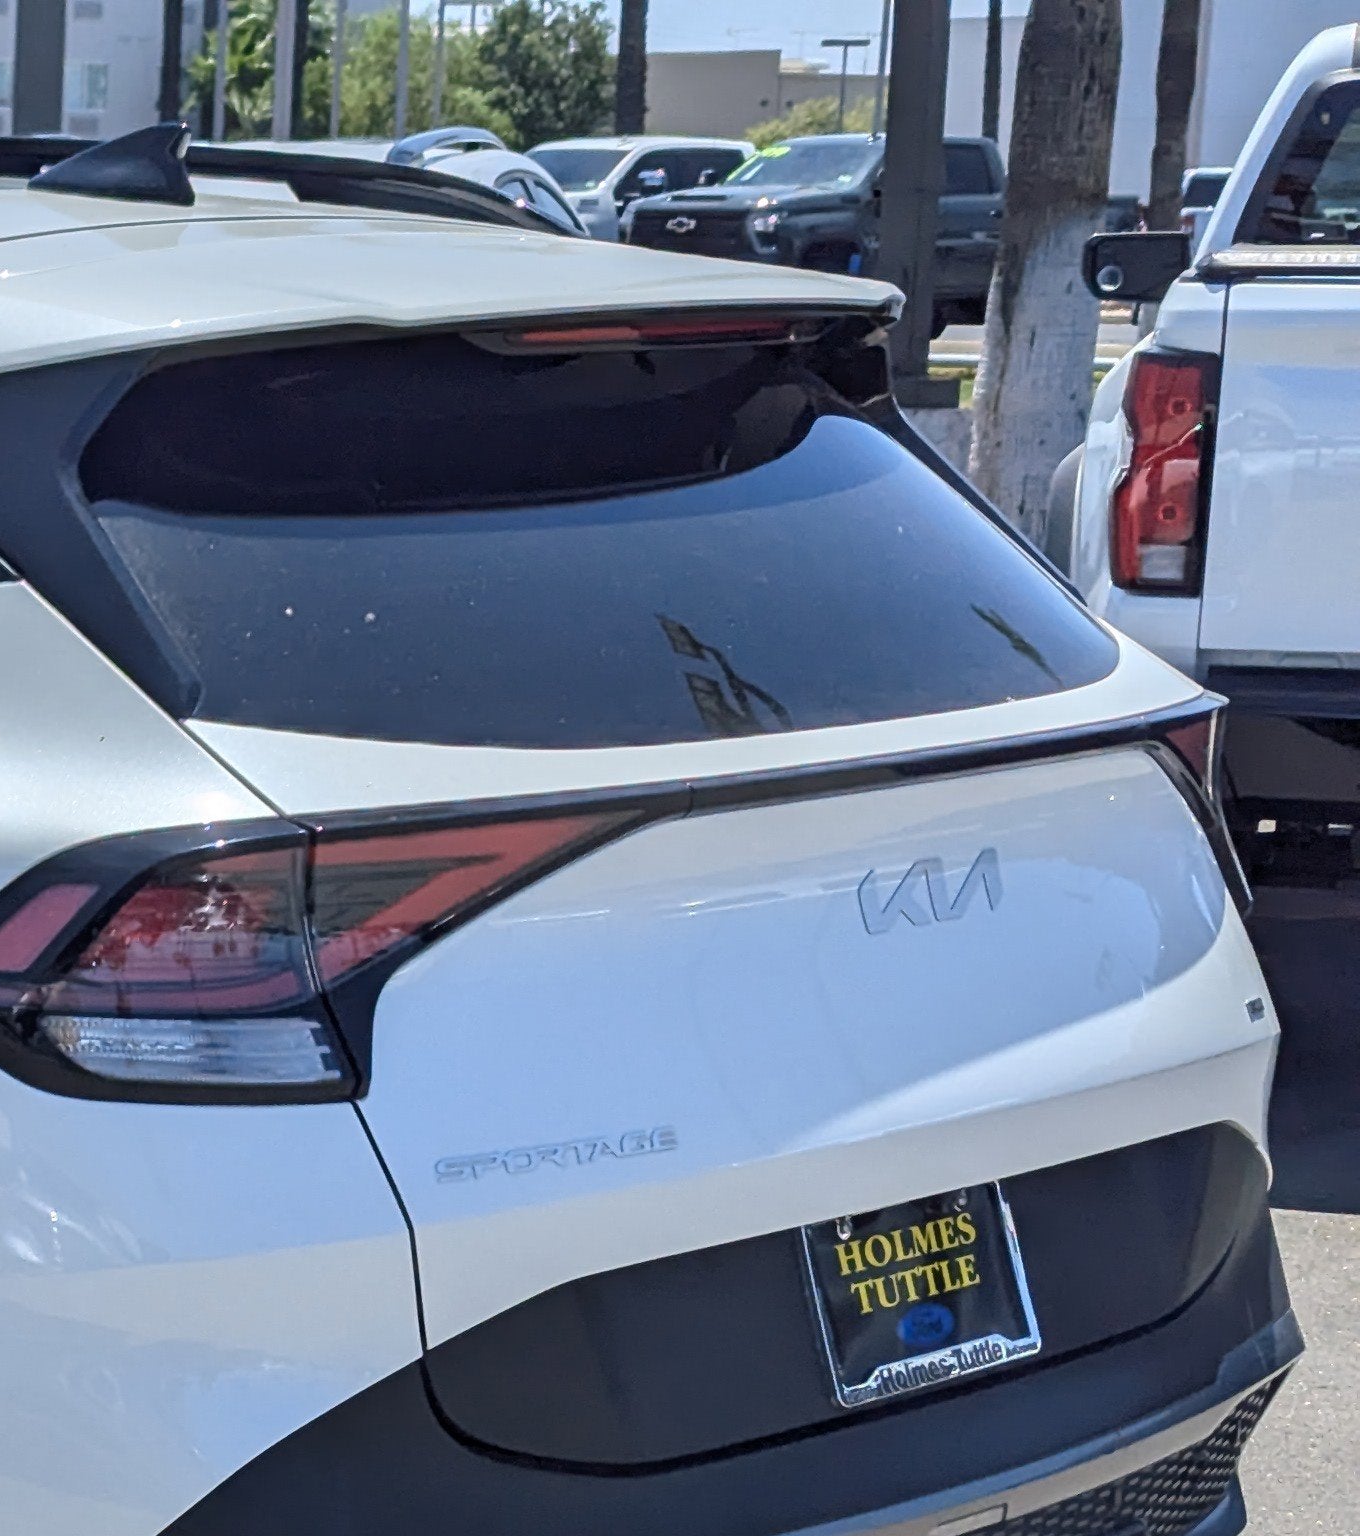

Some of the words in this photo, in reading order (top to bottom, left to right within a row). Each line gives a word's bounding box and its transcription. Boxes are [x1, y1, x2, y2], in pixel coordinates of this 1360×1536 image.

[434, 1124, 679, 1184] SPORTAGE
[835, 1211, 977, 1277] HOLMES
[850, 1253, 981, 1316] TUTTLE
